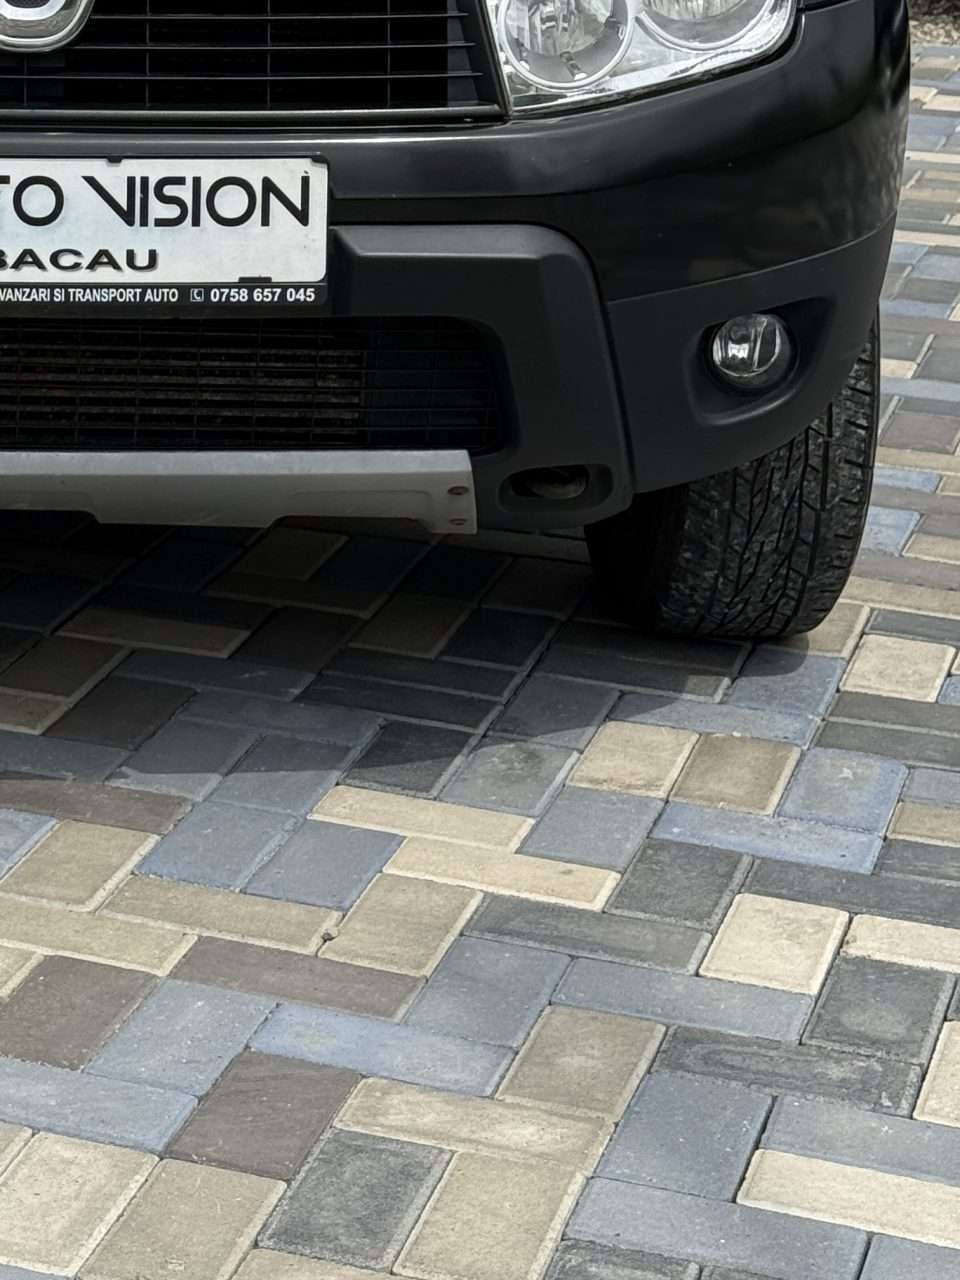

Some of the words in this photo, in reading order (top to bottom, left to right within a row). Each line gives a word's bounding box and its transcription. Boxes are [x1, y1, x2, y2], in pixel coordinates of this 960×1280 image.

[81, 175, 310, 227] VISION
[53, 288, 65, 302] SI
[67, 288, 142, 302] TRANSPORT
[145, 288, 179, 302] AUTO
[210, 288, 249, 302] 0758
[253, 288, 281, 302] 657
[286, 288, 316, 302] 045
